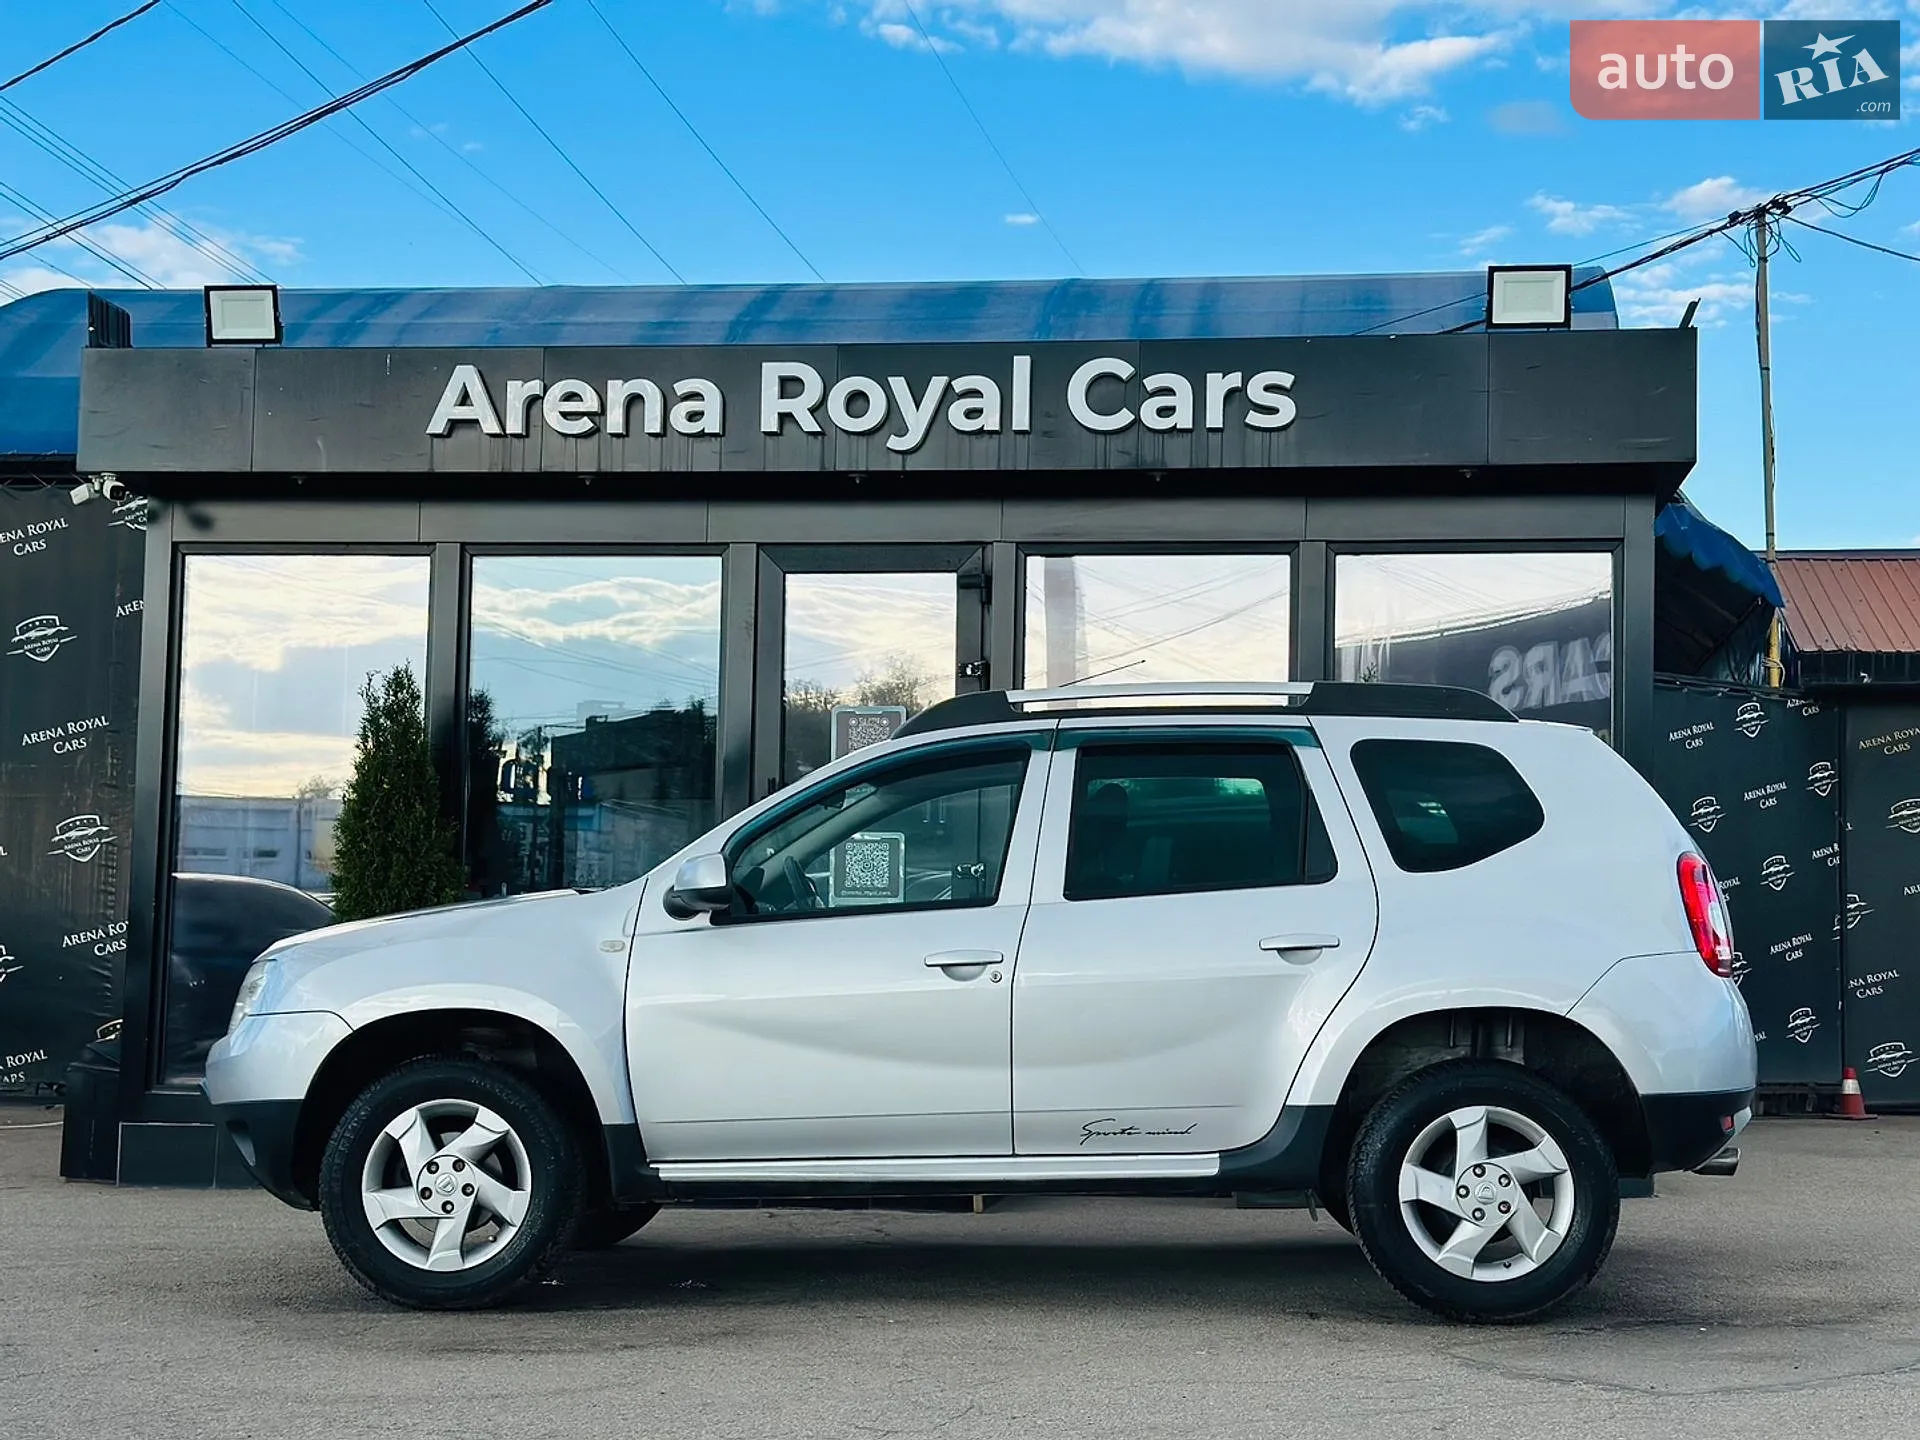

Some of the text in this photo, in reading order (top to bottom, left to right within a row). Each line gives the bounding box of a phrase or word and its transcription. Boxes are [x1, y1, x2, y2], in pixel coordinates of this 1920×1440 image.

[425, 355, 1297, 454] Arena Royal Cars
[0, 517, 69, 543] ENA ROYAL
[13, 538, 47, 556] CARS
[22, 715, 110, 746] ARENA ROYAL
[53, 737, 87, 754] CARS
[1858, 735, 1892, 750] ARENA
[1883, 741, 1911, 755] CARS
[62, 928, 106, 948] ARENA
[94, 938, 127, 956] CARS
[1866, 969, 1900, 984] ROYAL
[1855, 985, 1884, 999] CARS
[6, 1049, 48, 1068] ROYAL
